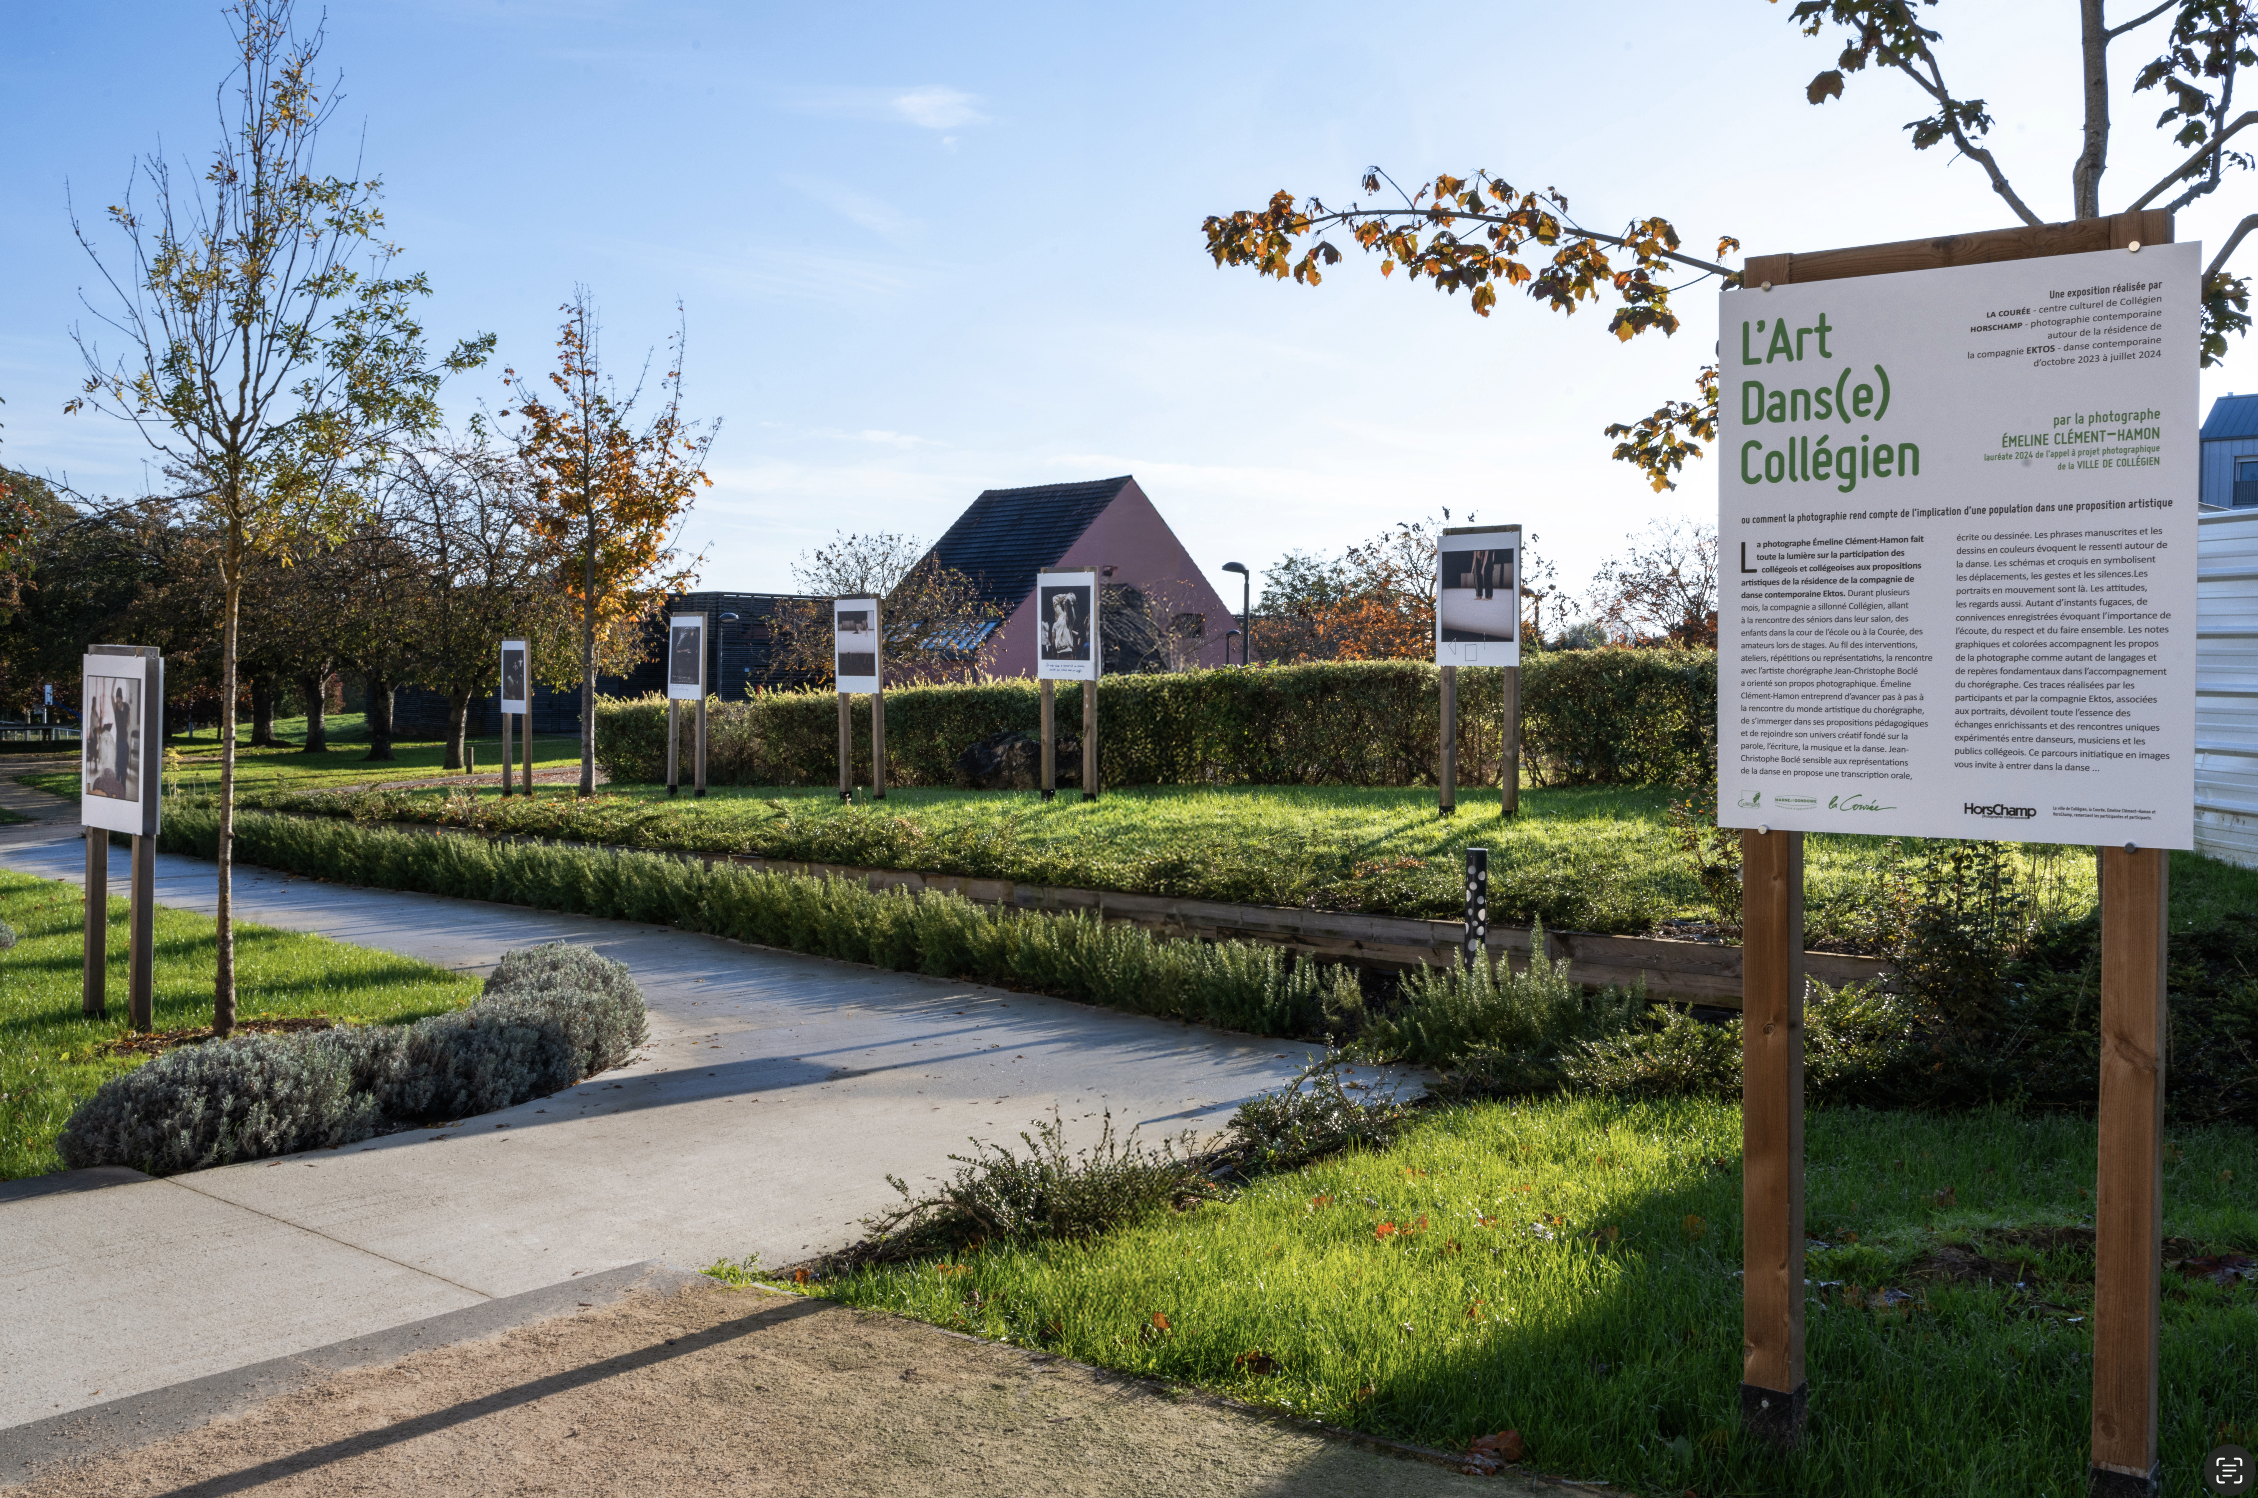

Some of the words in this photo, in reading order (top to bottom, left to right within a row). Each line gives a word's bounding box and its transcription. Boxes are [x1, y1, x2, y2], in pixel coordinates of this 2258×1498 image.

[2049, 290, 2064, 299] Une
[2067, 285, 2110, 298] exposition
[2112, 281, 2145, 293] réalisée
[2148, 281, 2162, 292] par
[1998, 306, 2030, 317] COURÉE
[2038, 305, 2066, 313] centre
[2069, 300, 2103, 310] culturel
[2106, 299, 2117, 307] de
[2119, 295, 2162, 305] Collégien
[1970, 322, 2022, 332] HORSCHAMP
[2030, 315, 2090, 328] photographie
[2092, 310, 2162, 321] contemporaine
[2047, 331, 2076, 339] autour
[2079, 328, 2090, 336] de
[2093, 327, 2100, 335] la
[2103, 325, 2147, 334] résidence
[2150, 322, 2161, 330] de
[1967, 351, 1974, 359] la
[1976, 347, 2024, 358] compagnie
[2026, 344, 2055, 354] EKTOS
[2063, 343, 2089, 351] danse
[2092, 336, 2161, 348] contemporaine
[2078, 354, 2099, 363] 2023
[2110, 352, 2135, 362] juillet
[2138, 349, 2161, 358] 2024
[1742, 364, 1890, 425] Dans(e)
[2053, 416, 2071, 428] par
[2075, 412, 2084, 424] la
[2088, 407, 2160, 426] photographe
[2002, 432, 2049, 448] ÉMELINE
[1984, 452, 2012, 461] lauréate
[2015, 451, 2033, 460] 2024
[2035, 450, 2043, 458] de
[2071, 448, 2075, 456] à
[2077, 447, 2099, 457] projet
[2102, 445, 2160, 456] photographique
[1741, 434, 1919, 493] Collégien
[2058, 462, 2066, 470] de
[2068, 462, 2075, 470] la
[2076, 459, 2098, 469] VILLE
[2102, 458, 2112, 468] DE
[2116, 455, 2160, 467] COLLÉGIEN
[1752, 513, 1786, 523] comment
[1788, 513, 1794, 522] la
[1797, 511, 1847, 523] photographie
[1849, 510, 1866, 519] rend
[1868, 509, 1898, 520] compte
[1900, 508, 1909, 517] de
[1988, 503, 2033, 516] population
[2035, 502, 2055, 512] dans
[2057, 503, 2073, 511] une
[2076, 499, 2125, 513] proposition
[2128, 498, 2173, 509] artistique
[1762, 539, 1811, 549] photographe
[1812, 537, 1843, 546] Émeline
[1844, 536, 1908, 544] Clément-Hamon
[1956, 533, 1979, 541] écrite
[1993, 531, 2032, 540] dessinée.
[2050, 530, 2082, 539] phrases
[2084, 528, 2137, 536] manuscrites
[1778, 552, 1784, 560] la
[1786, 551, 1815, 559] lumière
[1839, 549, 1889, 559] participation
[1890, 548, 1904, 556] des
[1956, 546, 1985, 554] dessins
[1999, 545, 2034, 553] couleurs
[2036, 544, 2076, 553] évoquent
[2078, 543, 2086, 551] le
[2088, 542, 2122, 550] ressenti
[1761, 565, 1798, 574] collégeois
[1808, 563, 1854, 573] collégeoises
[1872, 561, 1921, 571] propositions
[1740, 578, 1780, 587] artistiques
[1792, 577, 1799, 585] la
[1800, 576, 1837, 584] résidence
[1838, 576, 1849, 584] de
[1859, 575, 1902, 584] compagnie
[1904, 574, 1914, 582] de
[1764, 590, 1821, 599] contemporaine
[1822, 589, 1845, 597] Ektos.
[1875, 588, 1909, 597] plusieurs
[1954, 747, 1982, 755] publics
[1984, 747, 2026, 757] collégeois.
[2028, 748, 2039, 756] Ce
[2041, 750, 2078, 758] parcours
[2079, 750, 2123, 759] initiatique
[2138, 751, 2170, 761] images
[1974, 760, 1996, 768] invite
[2033, 762, 2053, 770] dans
[2055, 762, 2062, 770] la
[2064, 763, 2090, 771] danse
[1964, 802, 2036, 819] HorsChamp
